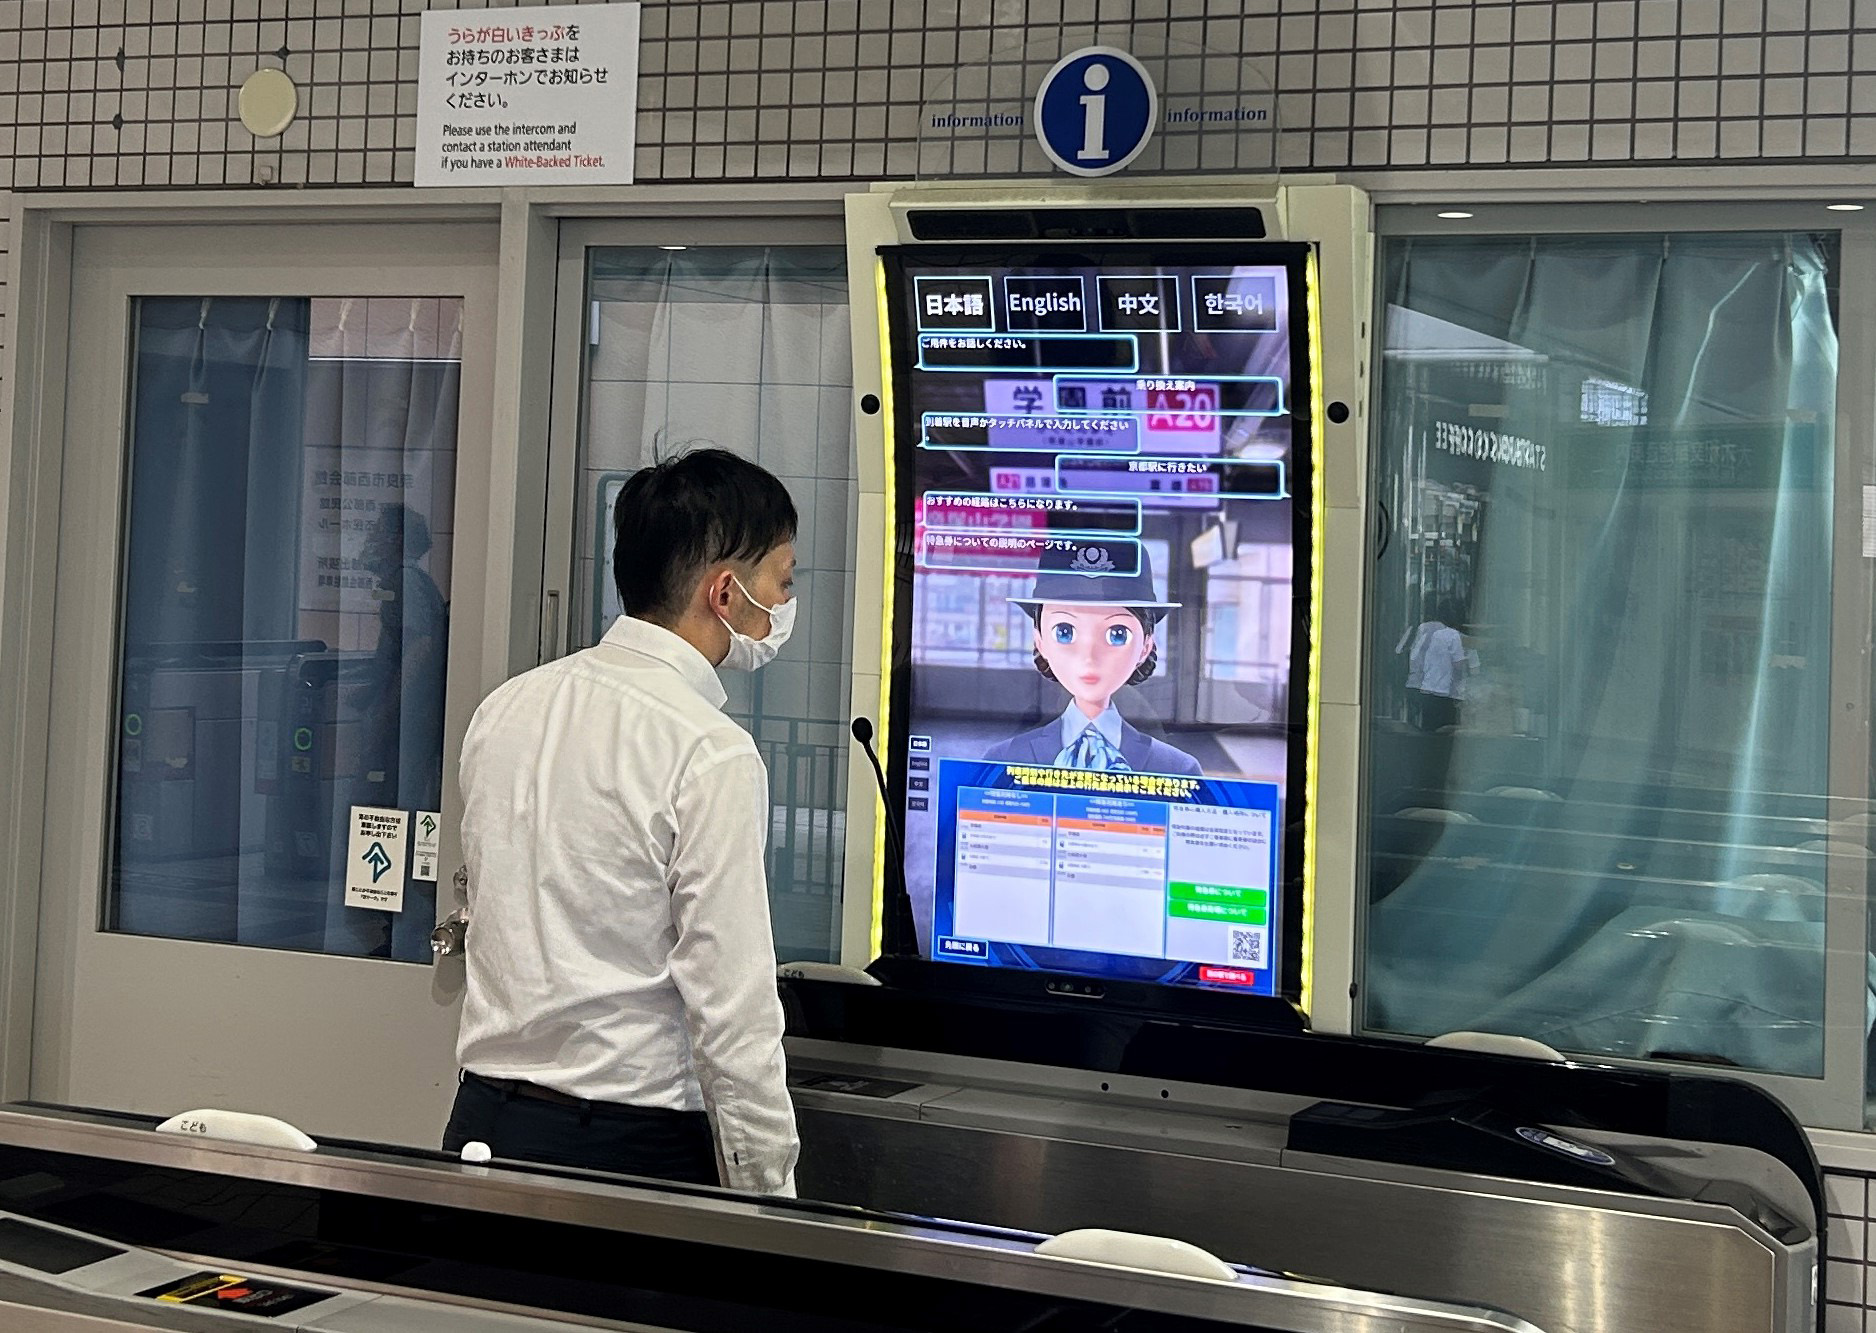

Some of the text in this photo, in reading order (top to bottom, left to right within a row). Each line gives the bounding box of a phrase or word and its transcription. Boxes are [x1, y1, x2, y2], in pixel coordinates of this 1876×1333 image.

[448, 24, 580, 45] うらが白いきっぷを
[446, 46, 580, 66] お持ちのお客さまは
[446, 67, 608, 87] インターホンでお知らせ
[446, 92, 509, 109] ください。
[931, 112, 1024, 128] information
[1167, 106, 1267, 123] information
[443, 121, 576, 136] Please use the intercom and
[441, 138, 572, 152] contact a station attendant
[441, 155, 606, 172] if you have a White-Backed Ticket.
[926, 294, 984, 316] 日本語
[1009, 293, 1081, 315] English
[1117, 293, 1159, 314] 中文
[1205, 293, 1263, 315] 한국어
[1151, 393, 1212, 428] A20
[1128, 461, 1207, 473] 京都駅に行きたい
[180, 1120, 206, 1133] こども
